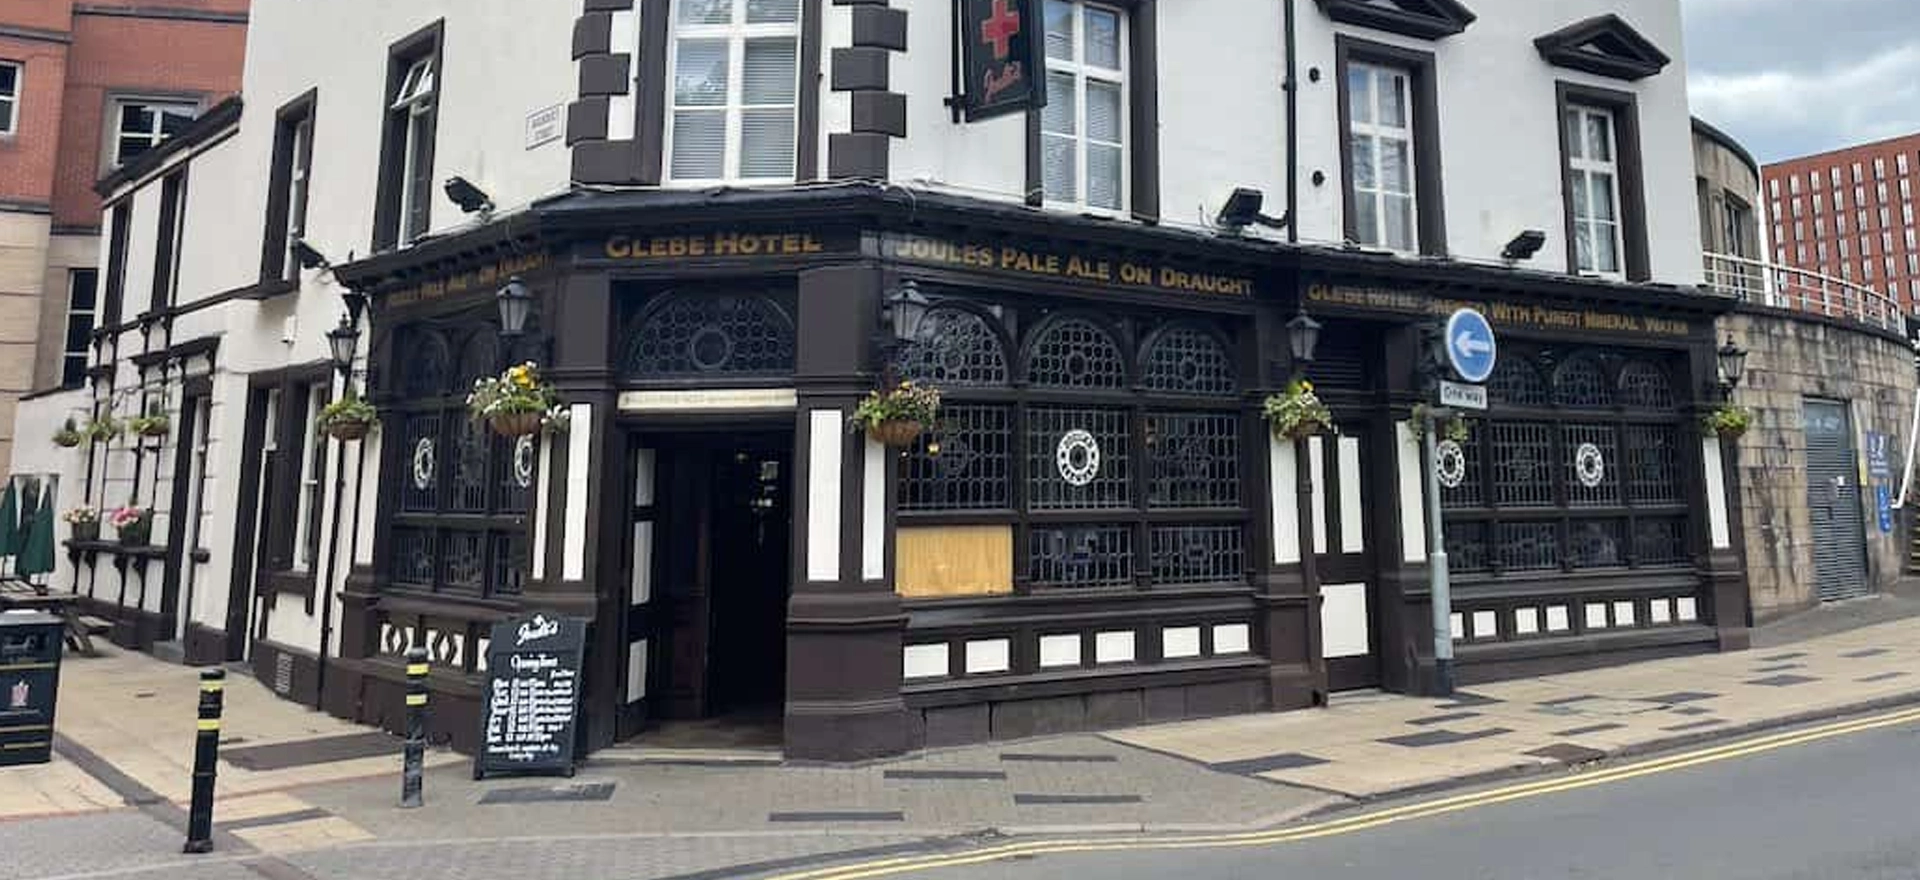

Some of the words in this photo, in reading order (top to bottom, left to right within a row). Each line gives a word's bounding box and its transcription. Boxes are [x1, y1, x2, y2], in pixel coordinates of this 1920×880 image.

[606, 235, 706, 258] GLEBE
[714, 232, 824, 255] HOTEL
[896, 239, 993, 267] JOULES
[1002, 248, 1060, 274] PALE
[1066, 255, 1110, 280] ALE
[1120, 263, 1151, 284] ON
[1161, 267, 1253, 295] DRAUGHT
[1492, 302, 1530, 324] WITH
